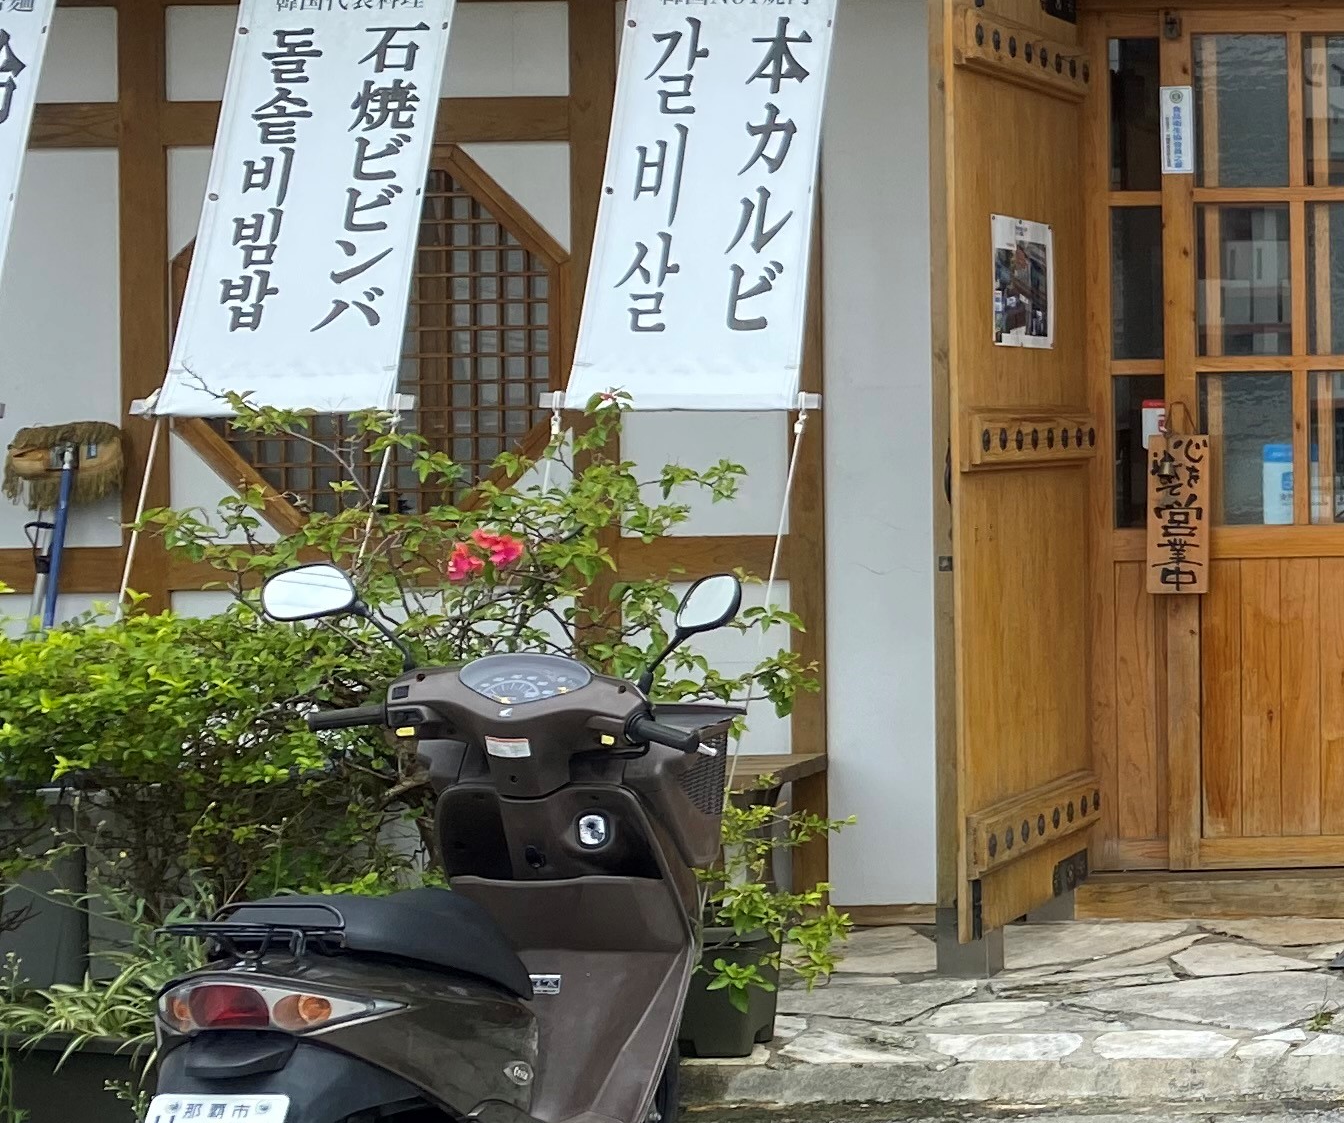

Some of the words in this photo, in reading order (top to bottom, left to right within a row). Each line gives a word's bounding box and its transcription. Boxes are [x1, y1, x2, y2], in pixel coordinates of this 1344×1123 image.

[219, 27, 323, 333] 돌솥비빔밥
[309, 21, 431, 333] 石焼ビビンバ
[613, 15, 710, 333] 갈비살
[723, 15, 813, 332] 本カルビ
